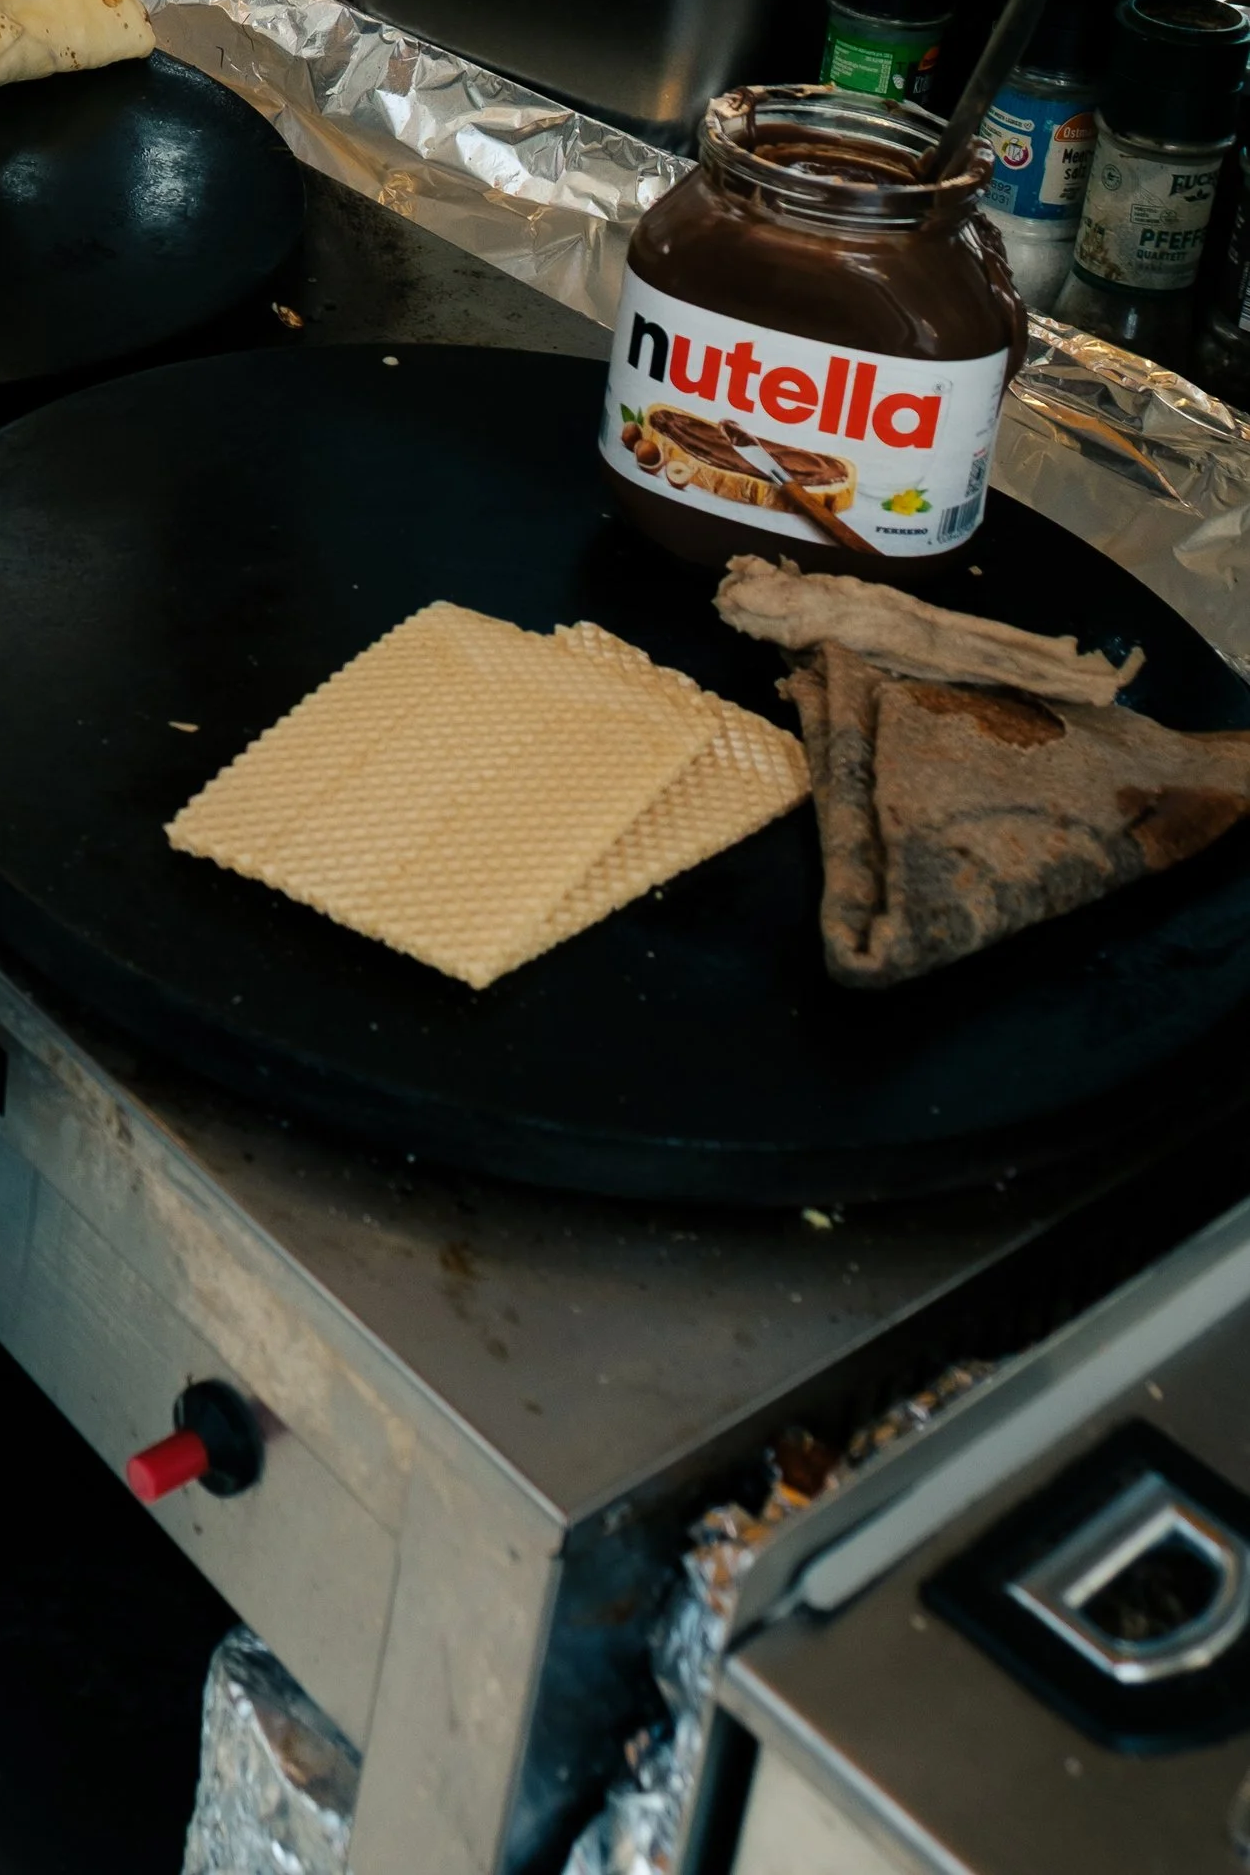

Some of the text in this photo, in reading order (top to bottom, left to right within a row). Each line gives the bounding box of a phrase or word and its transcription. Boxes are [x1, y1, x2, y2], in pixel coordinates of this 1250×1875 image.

[1137, 249, 1187, 262] QUARTETT
[628, 311, 941, 449] nutella
[876, 526, 928, 535] FERRERO
